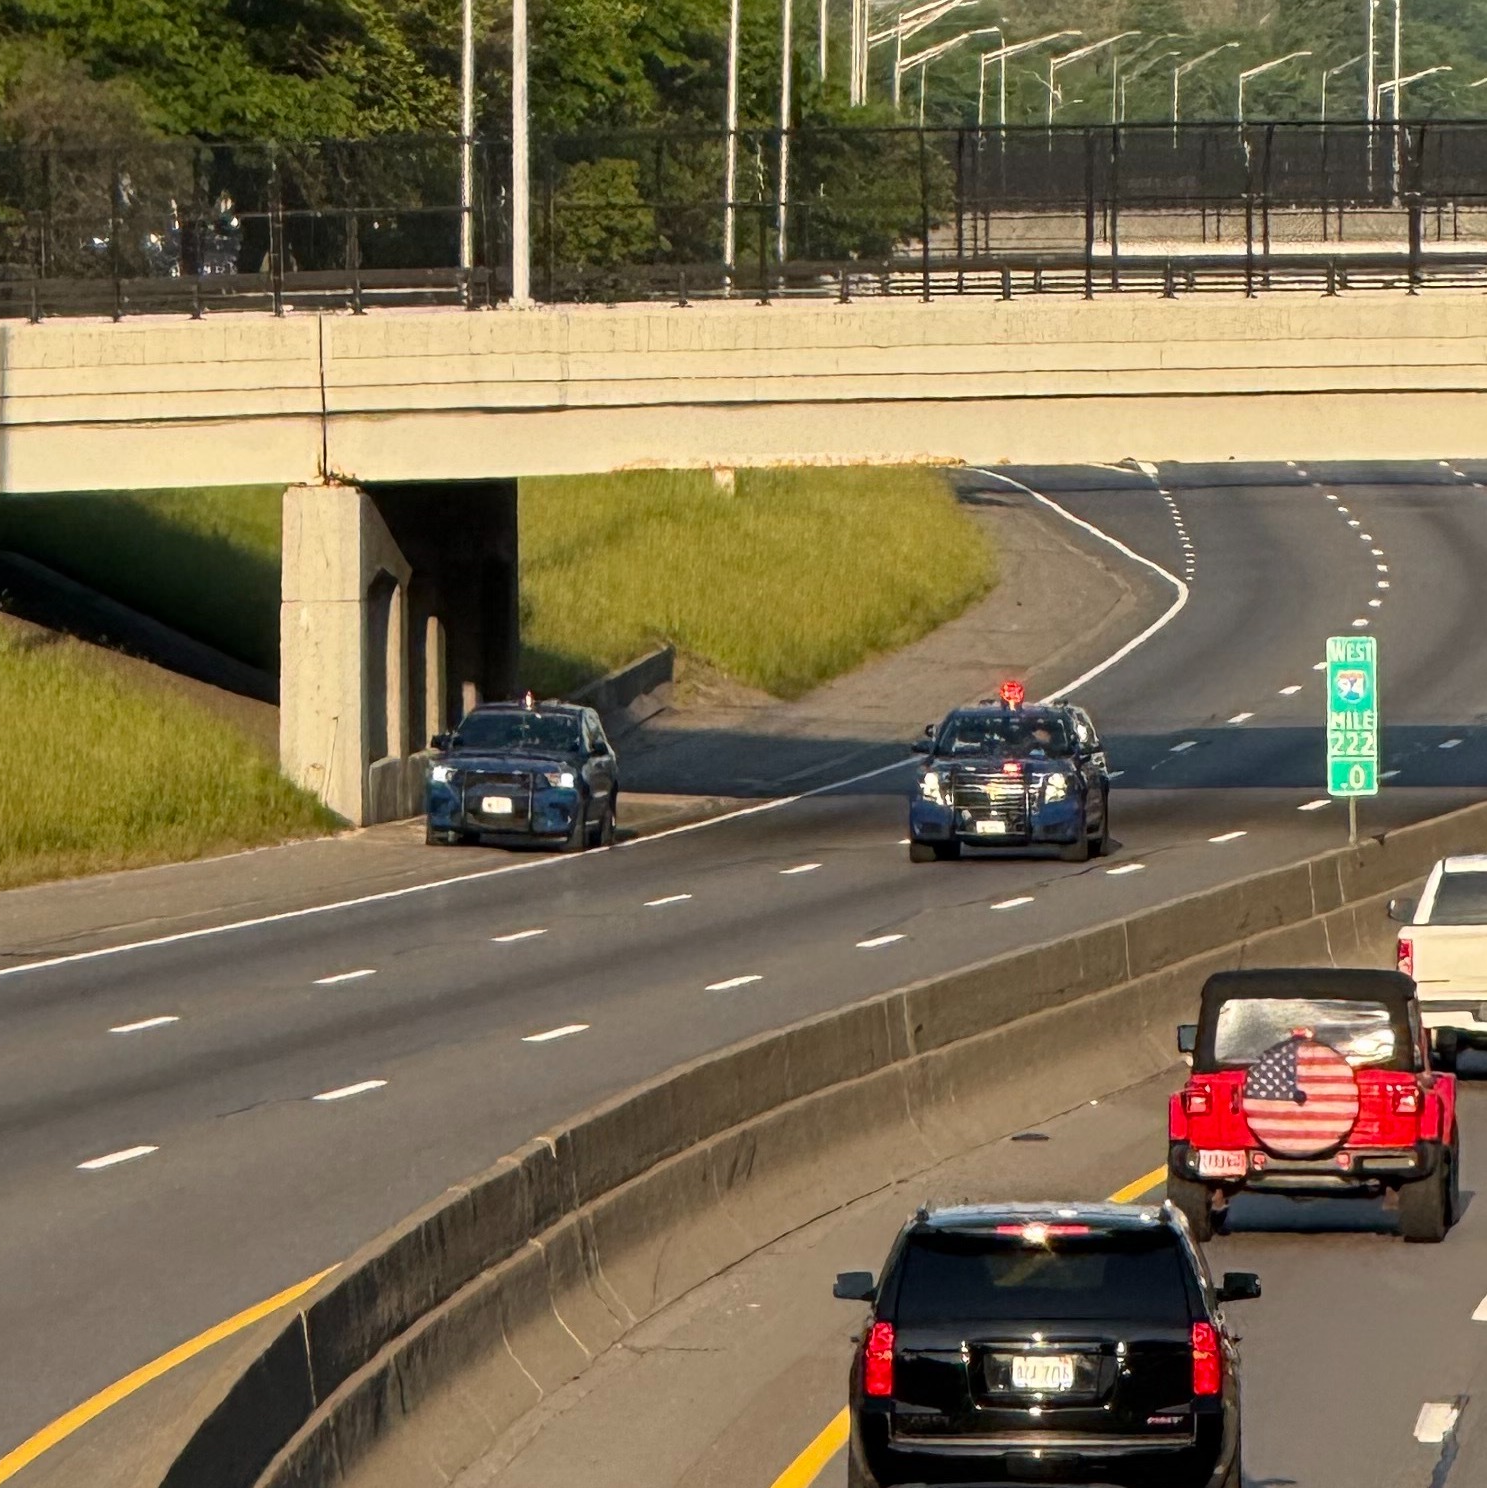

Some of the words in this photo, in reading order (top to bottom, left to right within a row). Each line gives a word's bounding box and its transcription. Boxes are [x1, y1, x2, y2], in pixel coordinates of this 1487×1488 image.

[1330, 641, 1373, 662] WEST
[1331, 711, 1374, 730] MILE
[1331, 733, 1374, 755] 222
